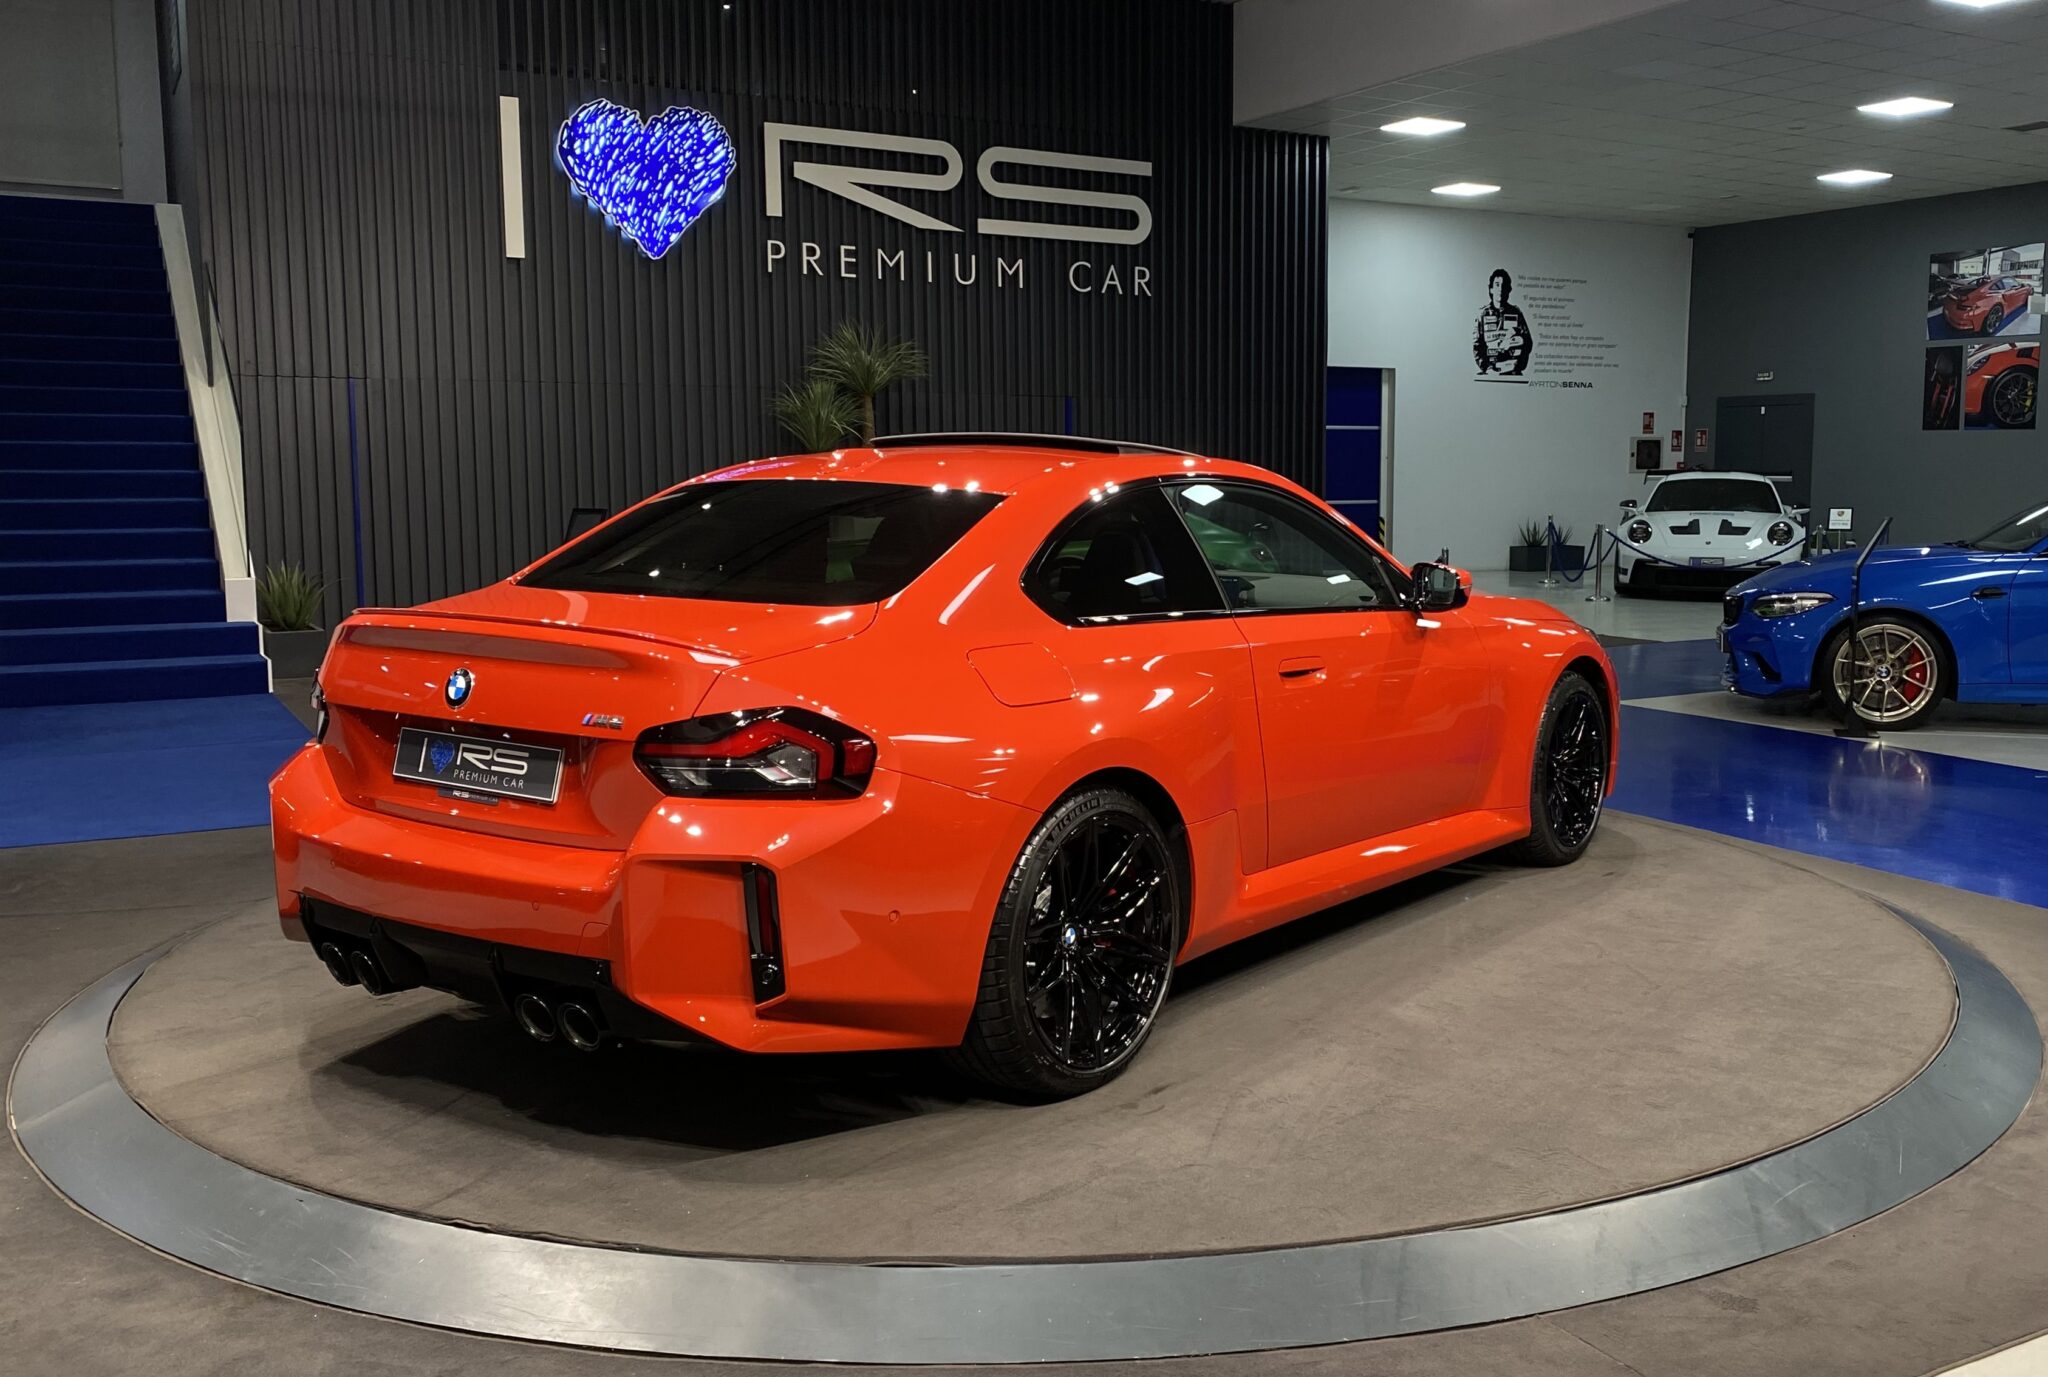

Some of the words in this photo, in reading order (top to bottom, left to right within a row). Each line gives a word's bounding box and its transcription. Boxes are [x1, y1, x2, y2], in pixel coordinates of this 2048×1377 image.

[500, 95, 525, 259] I
[764, 121, 1153, 246] RS
[766, 239, 1024, 289] PREMIUM
[1068, 261, 1152, 297] CAR
[456, 742, 530, 776] RS
[452, 789, 470, 799] RS
[453, 769, 498, 785] PREMIUM
[502, 776, 525, 790] CAR
[1049, 797, 1100, 842] MICHELIN
